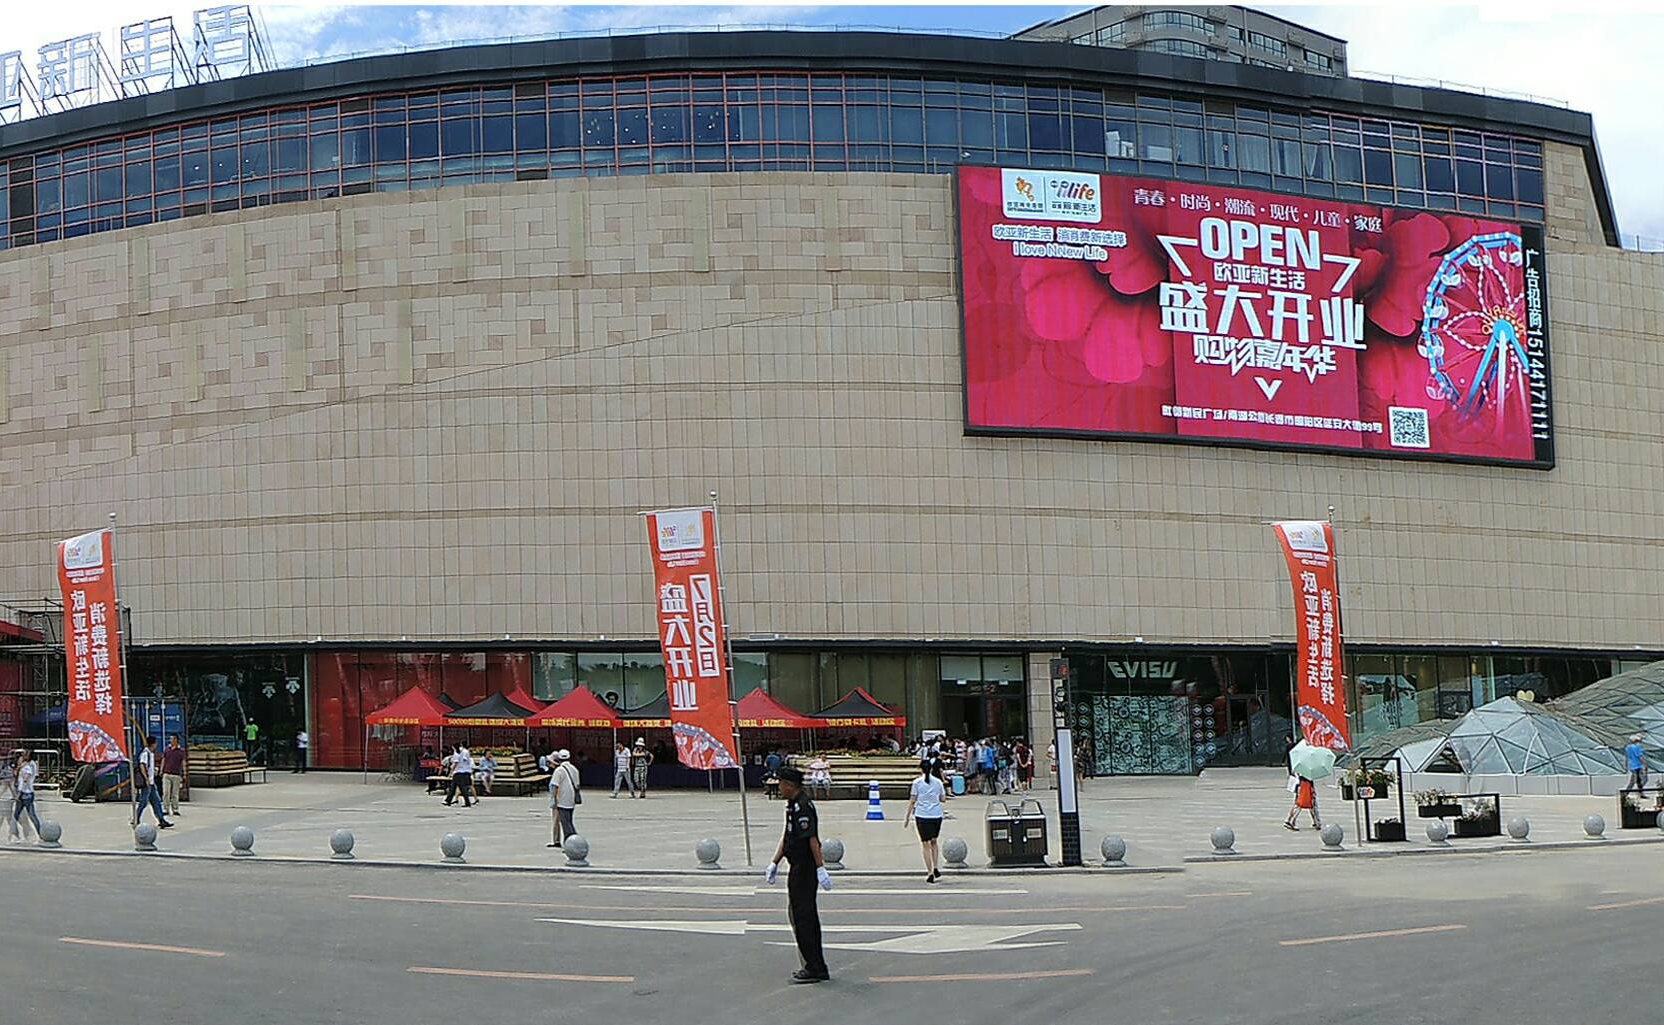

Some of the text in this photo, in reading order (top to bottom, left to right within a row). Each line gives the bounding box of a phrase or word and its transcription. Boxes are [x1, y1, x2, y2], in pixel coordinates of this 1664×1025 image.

[1199, 217, 1322, 271] OPEN
[1213, 262, 1305, 290] 欧亚新生活
[1159, 280, 1368, 350] 盛大开业
[1192, 334, 1337, 384] 购物嘉年华
[1107, 661, 1178, 679] EVISU
